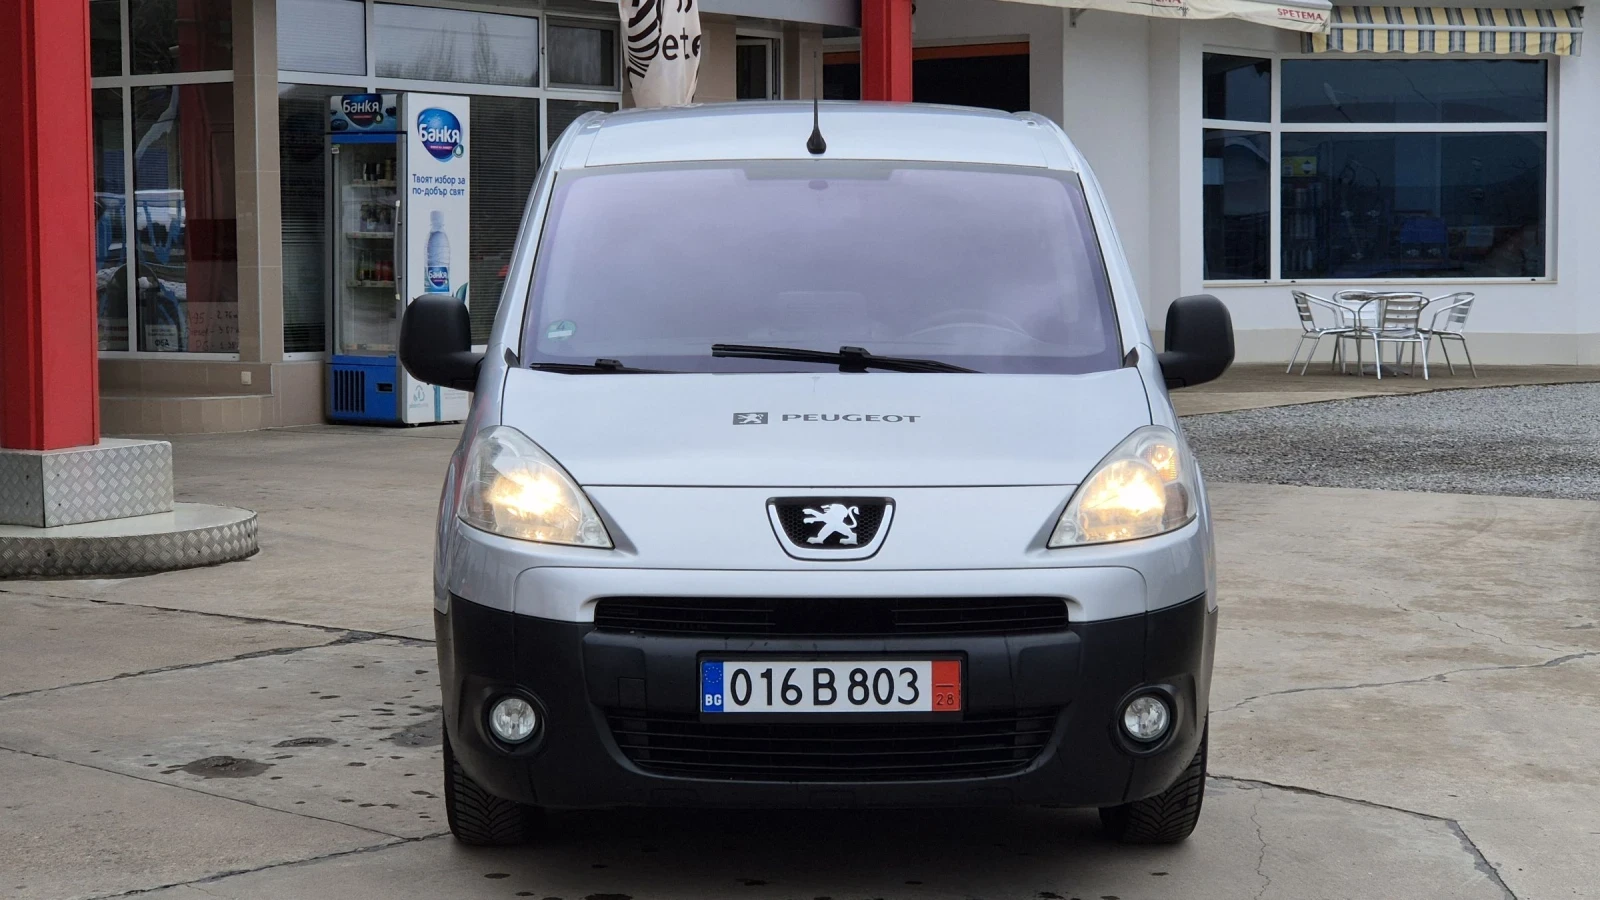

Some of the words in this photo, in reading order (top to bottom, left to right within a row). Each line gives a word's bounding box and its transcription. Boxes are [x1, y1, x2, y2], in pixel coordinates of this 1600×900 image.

[1277, 8, 1324, 21] SPETEMA
[342, 99, 380, 113] Банкя
[418, 123, 460, 143] Банкя
[412, 173, 433, 184] Твоят
[434, 174, 456, 186] избор
[457, 177, 466, 185] за
[412, 186, 448, 197] по-добър
[449, 188, 465, 196] свят
[556, 321, 565, 331] 4
[781, 413, 921, 423] PEUGEOT
[704, 694, 722, 706] BG
[935, 693, 954, 706] 28
